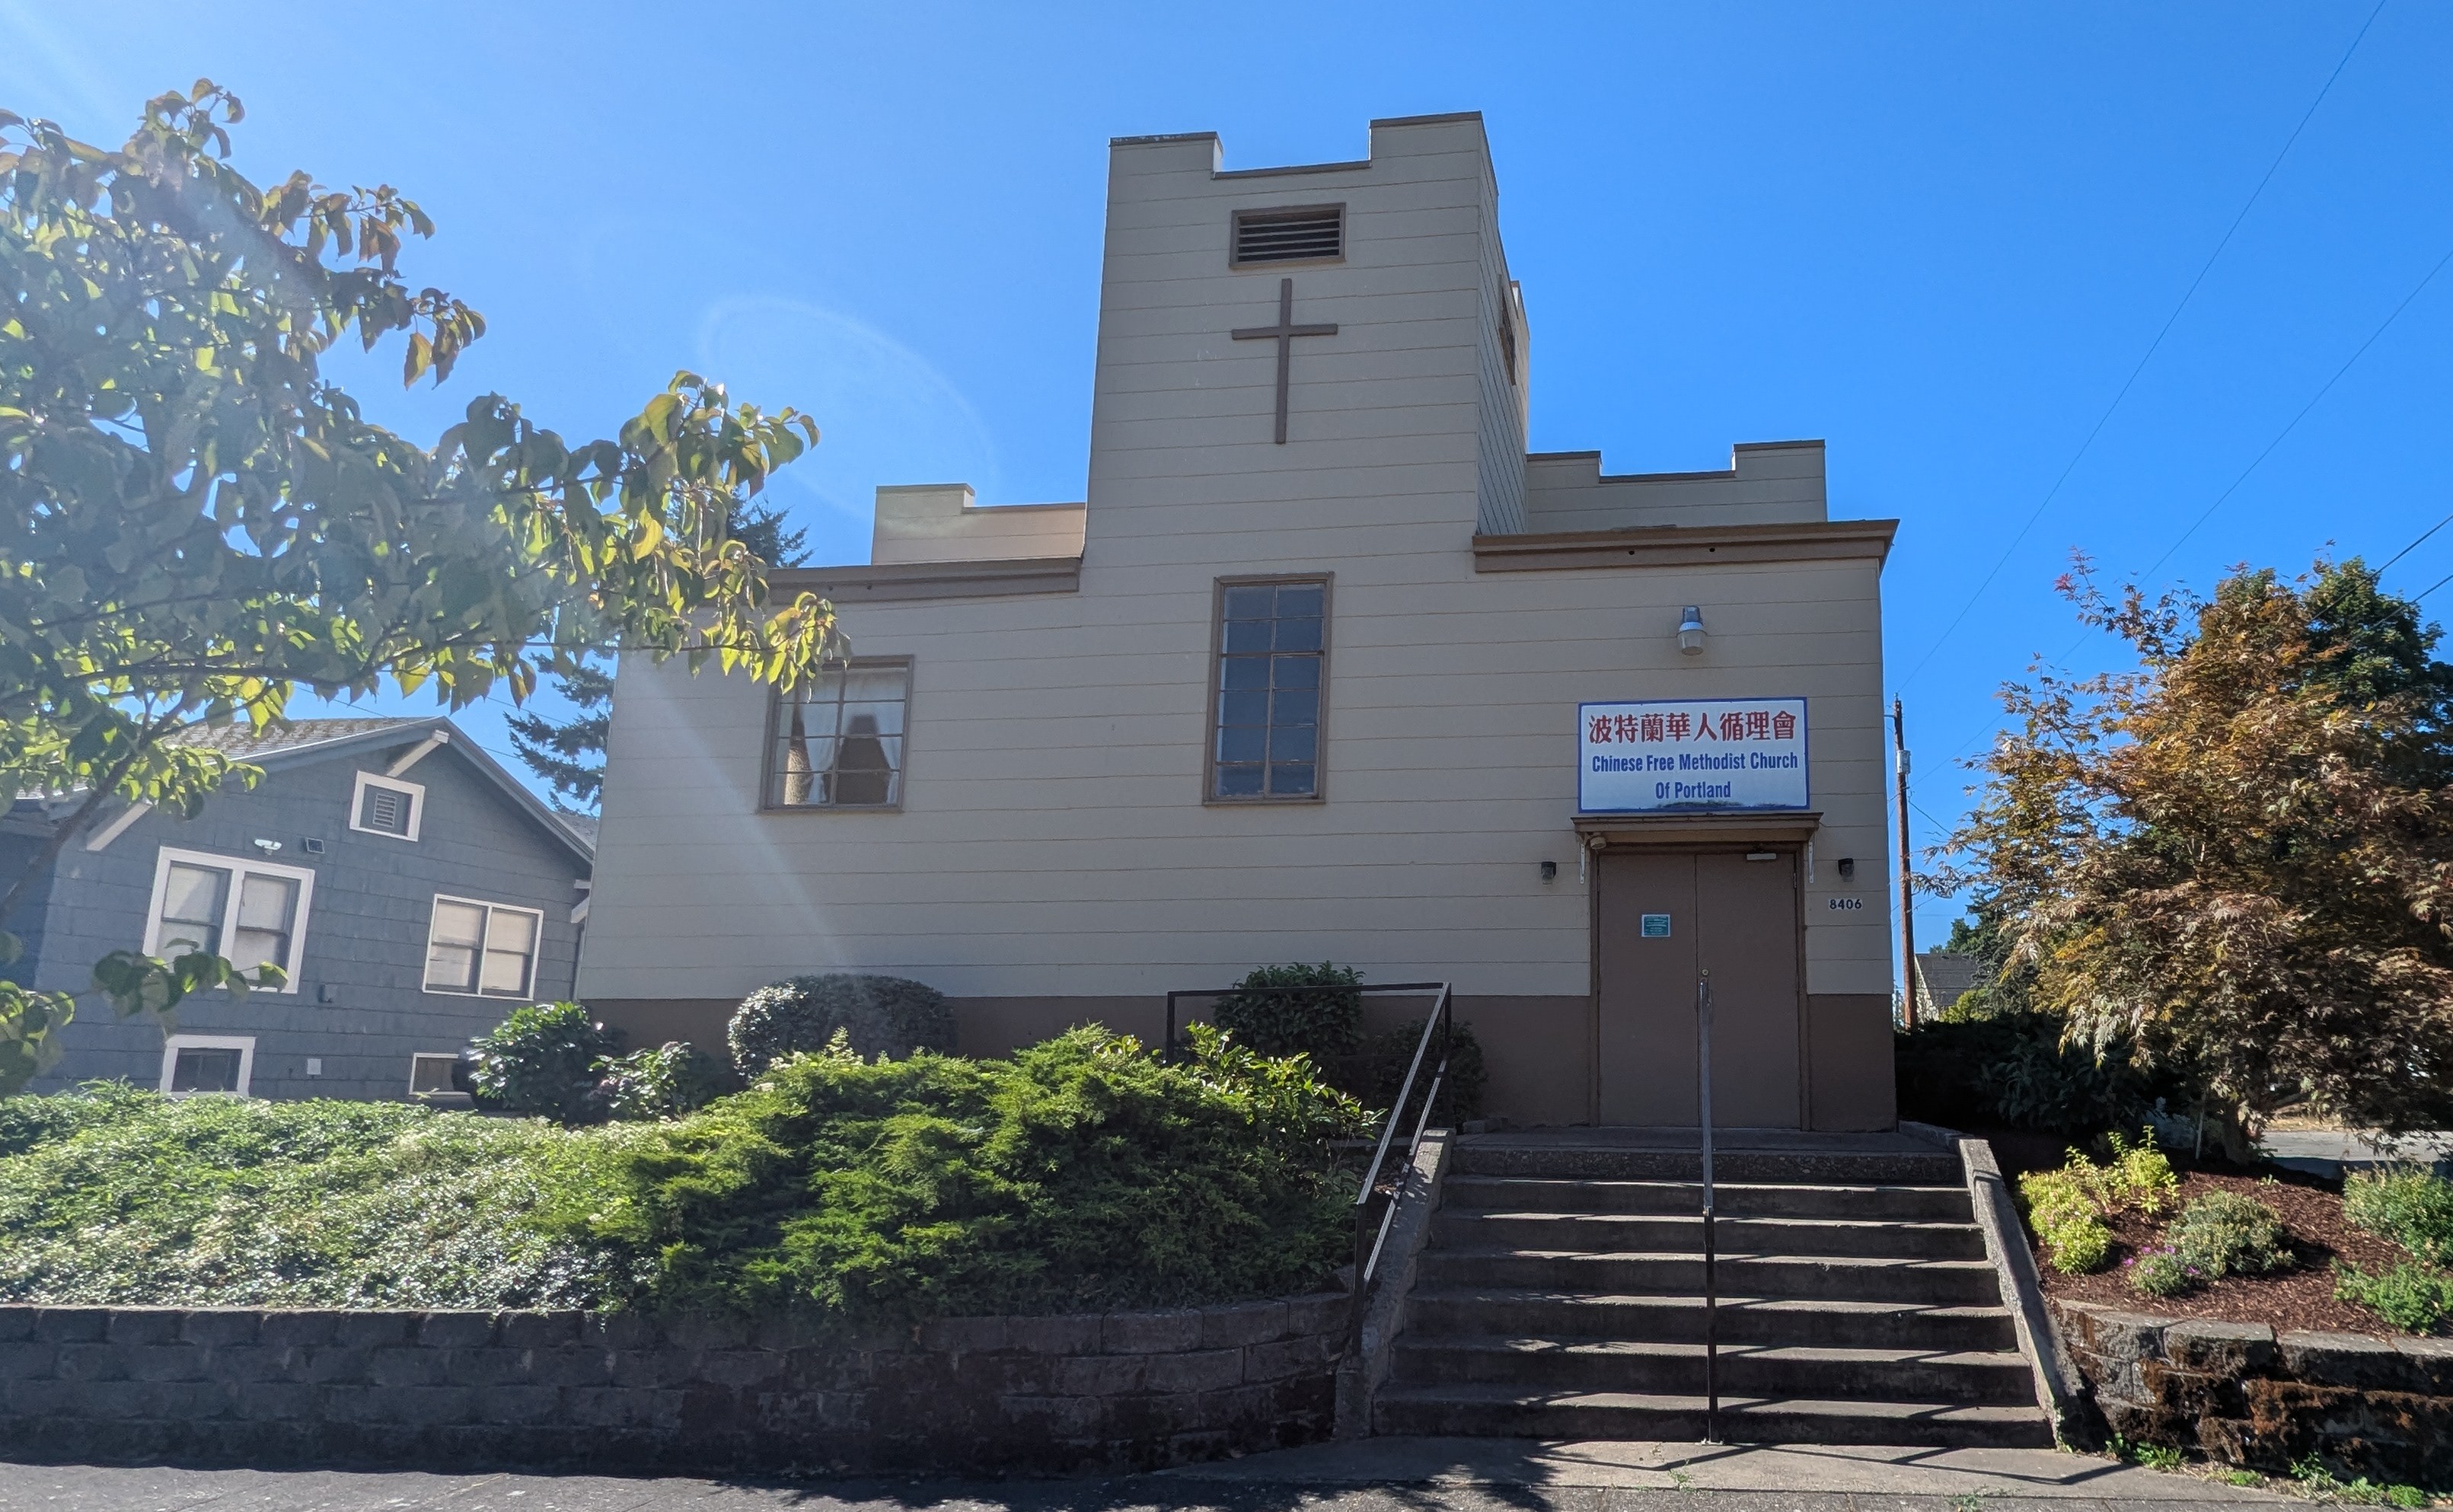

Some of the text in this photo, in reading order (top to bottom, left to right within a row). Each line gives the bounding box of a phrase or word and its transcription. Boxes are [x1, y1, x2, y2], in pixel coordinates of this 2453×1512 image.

[1589, 710, 1796, 744] 波特蘭華人循理會
[1592, 751, 1798, 773] Chinese Free Methodist Church
[1655, 781, 1731, 799] Of Portland
[1829, 899, 1862, 910] 8406
